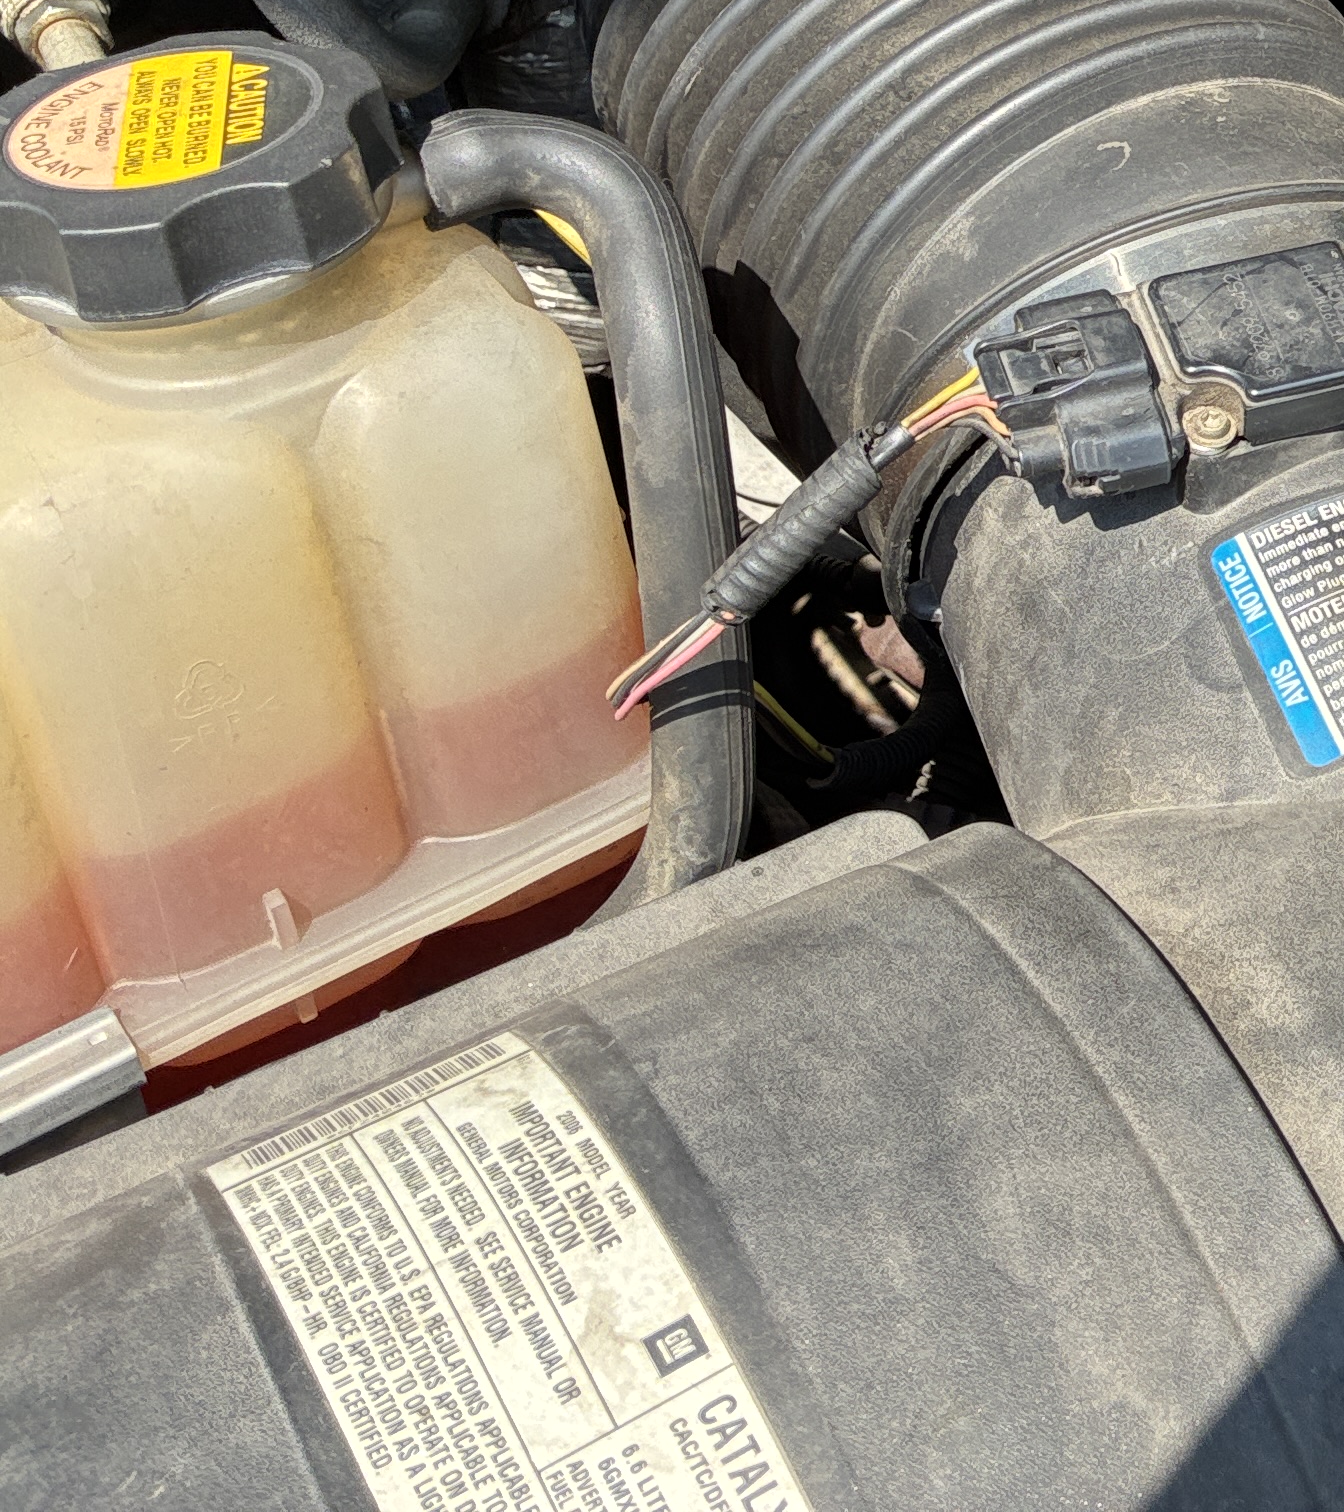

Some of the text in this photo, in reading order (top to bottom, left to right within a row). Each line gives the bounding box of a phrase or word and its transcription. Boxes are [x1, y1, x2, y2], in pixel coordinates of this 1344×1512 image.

[20, 81, 103, 179] ENGINE COOLANT
[65, 114, 86, 146] 15 PSI
[122, 70, 156, 176] ALWAYS OPEN SLOWLY.
[151, 77, 181, 163] NEVER OPEN HOT.
[182, 57, 218, 169] YOU CAN BE BURNED.
[225, 76, 270, 146] CAUTION
[1250, 512, 1319, 550] DIESEL
[1258, 526, 1330, 564] Immediate
[1266, 551, 1301, 579] more
[1302, 541, 1334, 563] than
[1217, 550, 1268, 626] NOTICE
[1273, 561, 1333, 594] charging
[1281, 586, 1316, 609] Glow
[1270, 657, 1309, 710] AVIS
[313, 1170, 349, 1208] ENGINES
[497, 1137, 585, 1253] INFORMATION
[508, 1100, 622, 1253] IMPORTANT ENGINE
[555, 1109, 636, 1219] 2006 MODEL YEAR
[313, 1217, 341, 1245] THIS
[334, 1205, 361, 1228] AND
[372, 1128, 512, 1347] OWNERS MANUAL FOR MORE INFORMATION.
[455, 1121, 578, 1306] GENERAL MOTORS CORPORATION
[326, 1242, 363, 1287] ENGINE
[334, 1157, 489, 1416] ENGINE CONFORMS TO U.S. EPA REGULATIONS
[346, 1225, 396, 1295] CALIFORNIA
[348, 1284, 371, 1302] IS
[407, 1126, 581, 1405] ADJUSTMENTS NEEDED. SEE SERVICE MANUAL OR
[270, 1248, 392, 1475] 2.4 OBD CERTIFIED.
[273, 1193, 426, 1479] PRIMARY INTENDED SERVICE APPLICATION AS A
[355, 1300, 406, 1371] CERTIFIED
[382, 1291, 446, 1390] REGULATIONS
[392, 1369, 418, 1394] TO
[403, 1394, 454, 1470] OPERATE
[430, 1391, 495, 1490] APPLICABLE
[621, 1443, 648, 1475] 6.6
[439, 1468, 468, 1499] ON
[545, 1469, 575, 1511] FUEL
